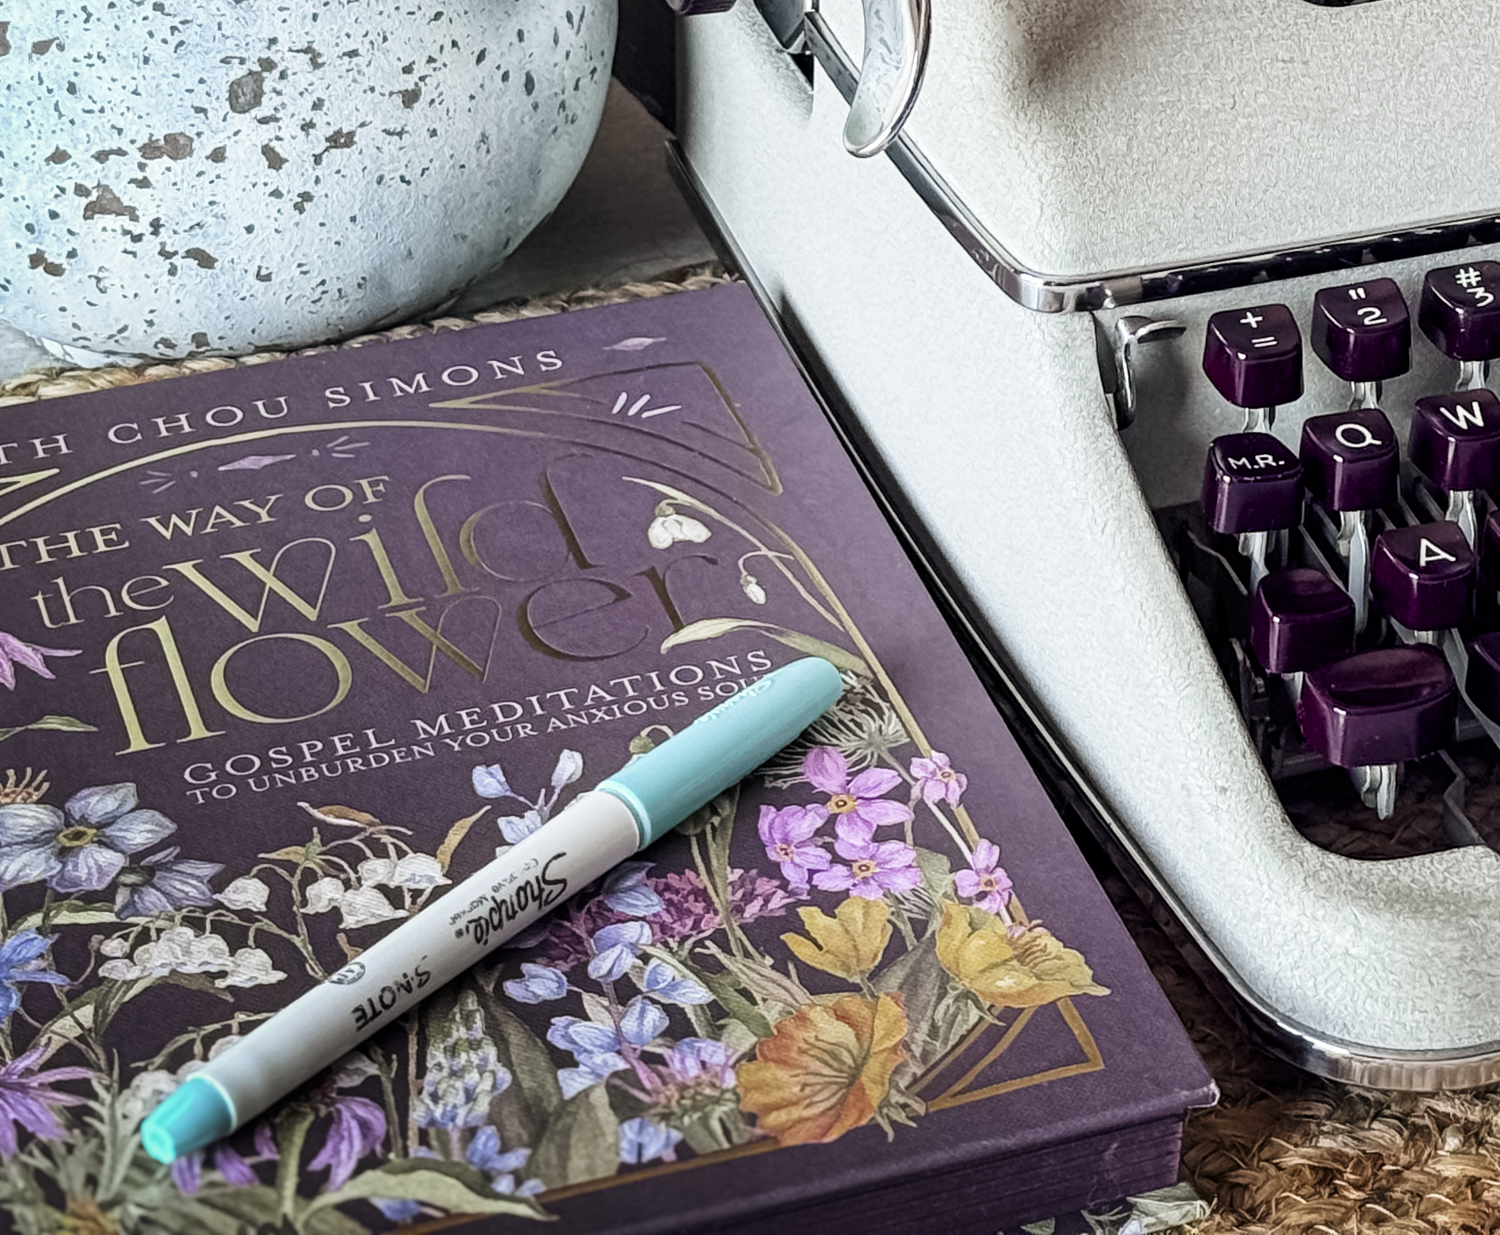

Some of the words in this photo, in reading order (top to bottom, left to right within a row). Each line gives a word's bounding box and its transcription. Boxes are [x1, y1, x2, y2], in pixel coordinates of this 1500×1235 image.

[1357, 307, 1386, 326] 2
[1468, 288, 1494, 307] 3
[1455, 268, 1481, 288] #
[108, 396, 289, 444] CHOU
[325, 350, 563, 409] SIMONS
[1228, 453, 1285, 471] M.R.
[1334, 423, 1382, 448] Q
[1439, 401, 1485, 430] W
[0, 523, 130, 570] THE
[140, 494, 283, 540] WAY
[304, 475, 390, 511] OF
[1418, 538, 1456, 566] A
[31, 576, 174, 628] the
[183, 728, 395, 785] GOSPEL
[411, 649, 772, 739] MEDITATIONS
[186, 783, 237, 804] TO
[248, 742, 435, 793] UNBURDEN
[445, 722, 538, 752] YOUR
[545, 691, 689, 733] ANXIOUS
